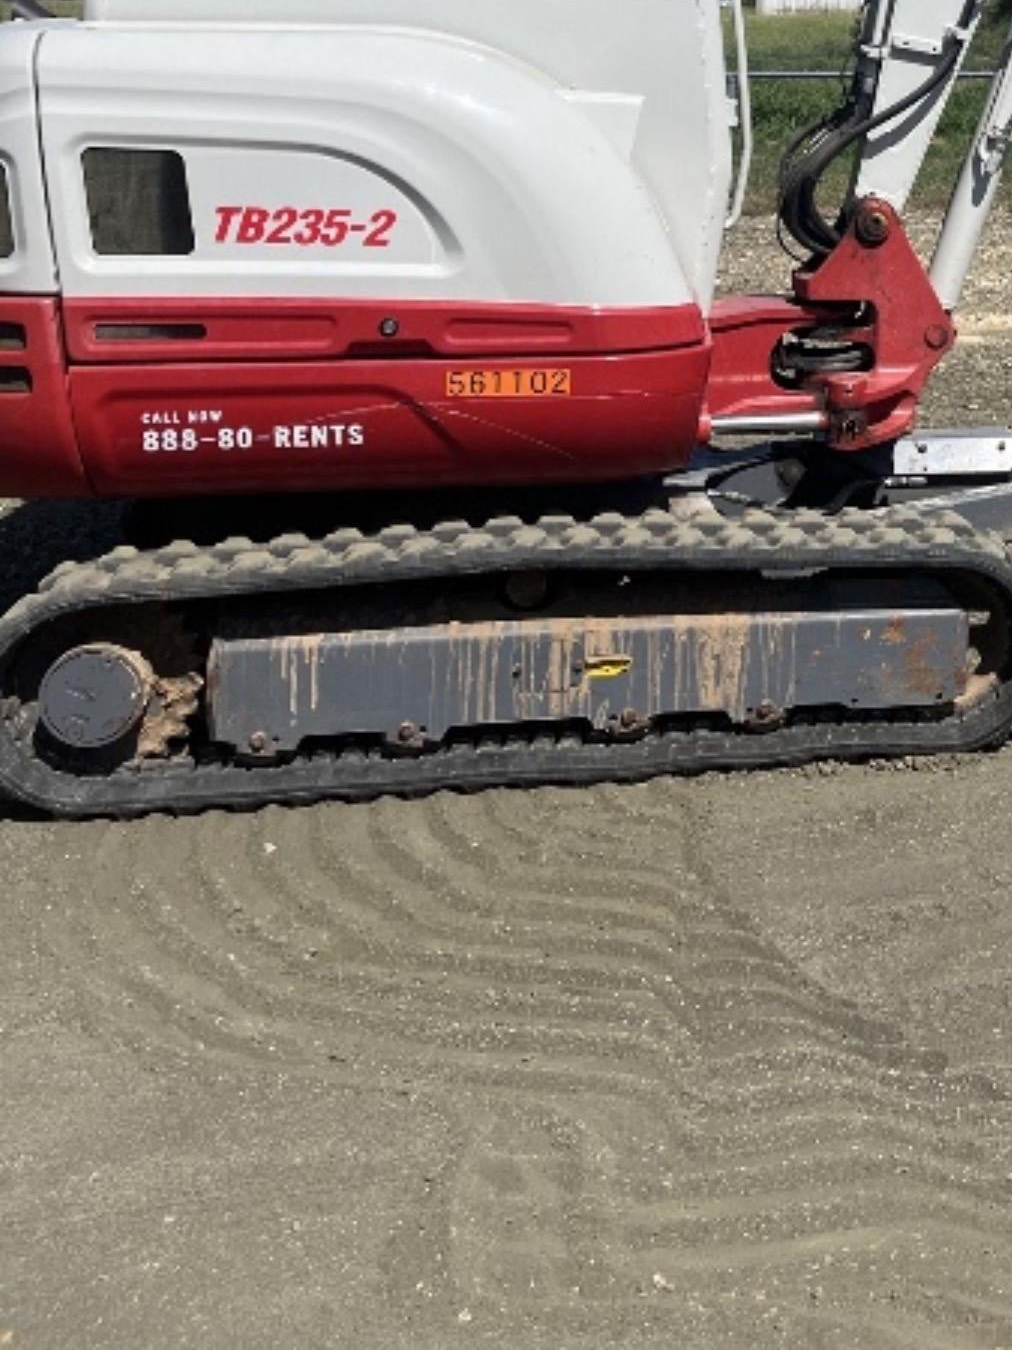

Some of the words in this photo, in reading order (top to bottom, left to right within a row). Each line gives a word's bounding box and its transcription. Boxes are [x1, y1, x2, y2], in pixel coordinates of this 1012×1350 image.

[214, 206, 397, 247] TB235-2
[448, 371, 568, 394] 561102
[140, 411, 181, 425] CALL
[187, 409, 223, 424] NOW
